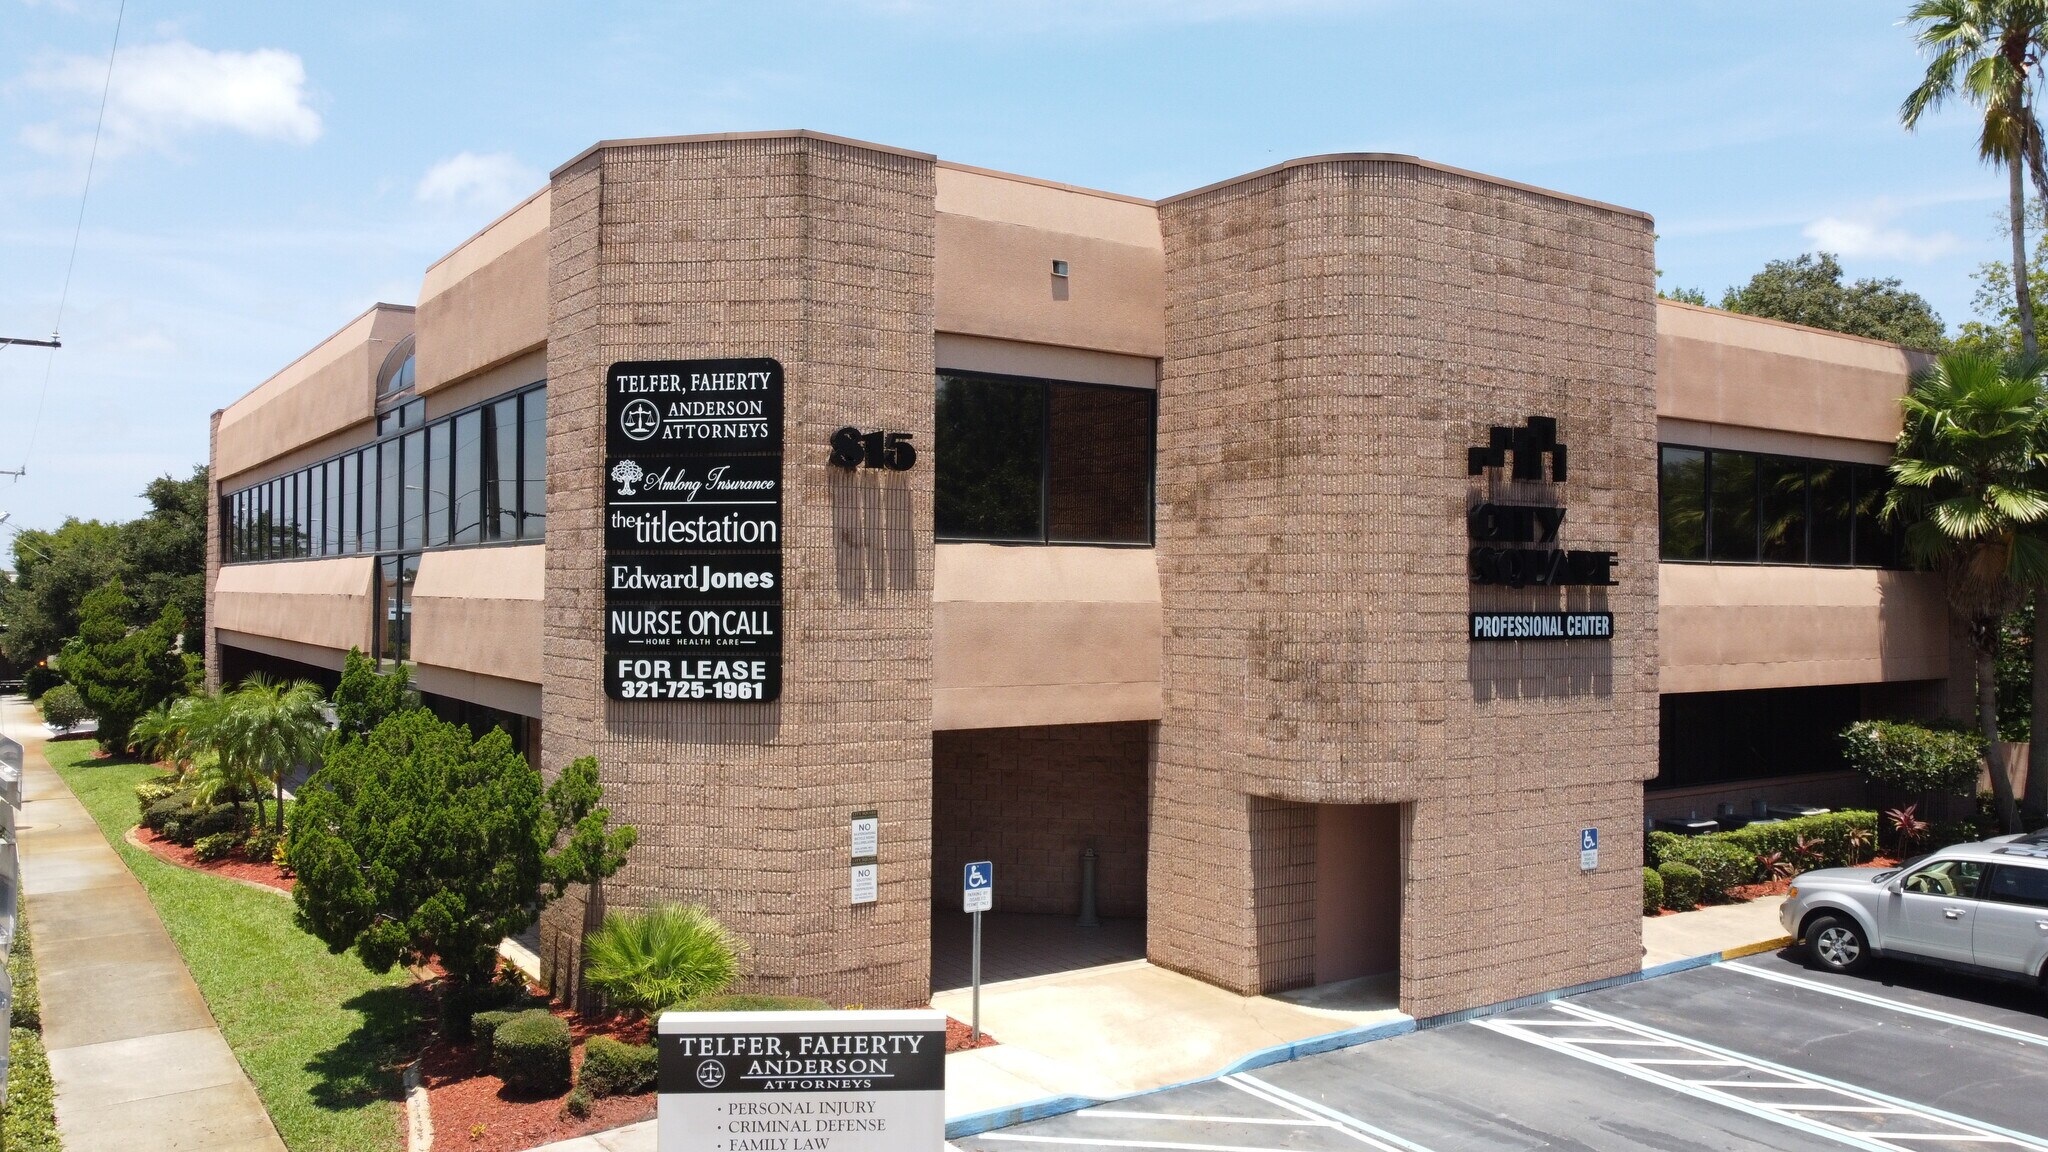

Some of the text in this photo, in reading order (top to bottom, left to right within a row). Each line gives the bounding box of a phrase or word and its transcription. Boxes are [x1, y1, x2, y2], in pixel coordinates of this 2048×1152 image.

[617, 372, 771, 395] TELFER, FAHERTY
[668, 400, 763, 417] ANDERSON
[662, 423, 769, 439] ATTORNEYS
[643, 465, 775, 502] Amlong Insurance
[612, 610, 682, 635] NURSE
[1474, 615, 1610, 638] PROFESSIONAL CENTER
[716, 638, 739, 646] CARE
[618, 660, 766, 680] FOR LEASE
[622, 681, 763, 699] 321-725-1961
[858, 823, 871, 831] NO
[858, 869, 871, 877] NO
[680, 1035, 924, 1058] TELFER, FAHERTY
[749, 1059, 888, 1075] ANDERSON
[764, 1079, 872, 1090] ATTORNEYS
[728, 1101, 876, 1116] PERSONAL INJURY
[728, 1119, 886, 1133] CRIMINAL DEFENSE
[730, 1138, 830, 1151] FAMILY LAW
